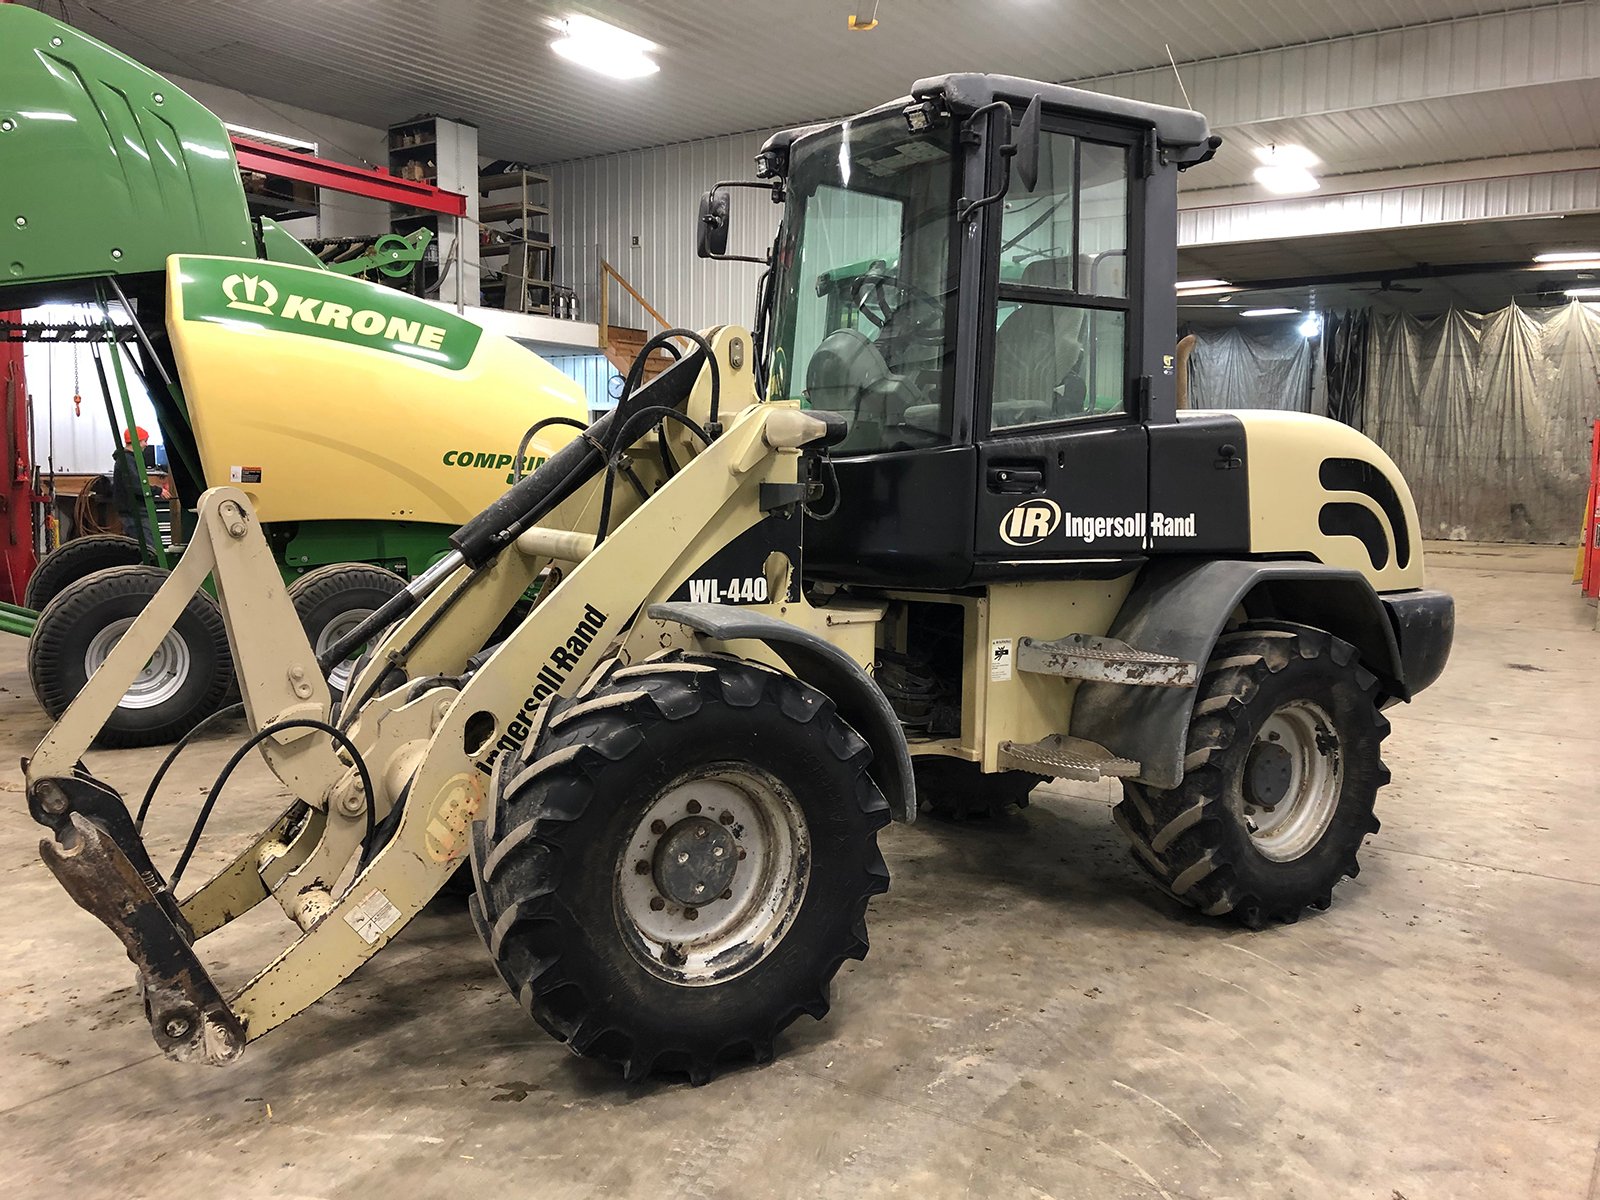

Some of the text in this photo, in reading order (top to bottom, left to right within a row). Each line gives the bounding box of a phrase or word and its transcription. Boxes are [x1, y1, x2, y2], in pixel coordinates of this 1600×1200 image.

[280, 294, 447, 350] KRONE
[1010, 507, 1051, 537] IR
[689, 577, 768, 603] WL-440
